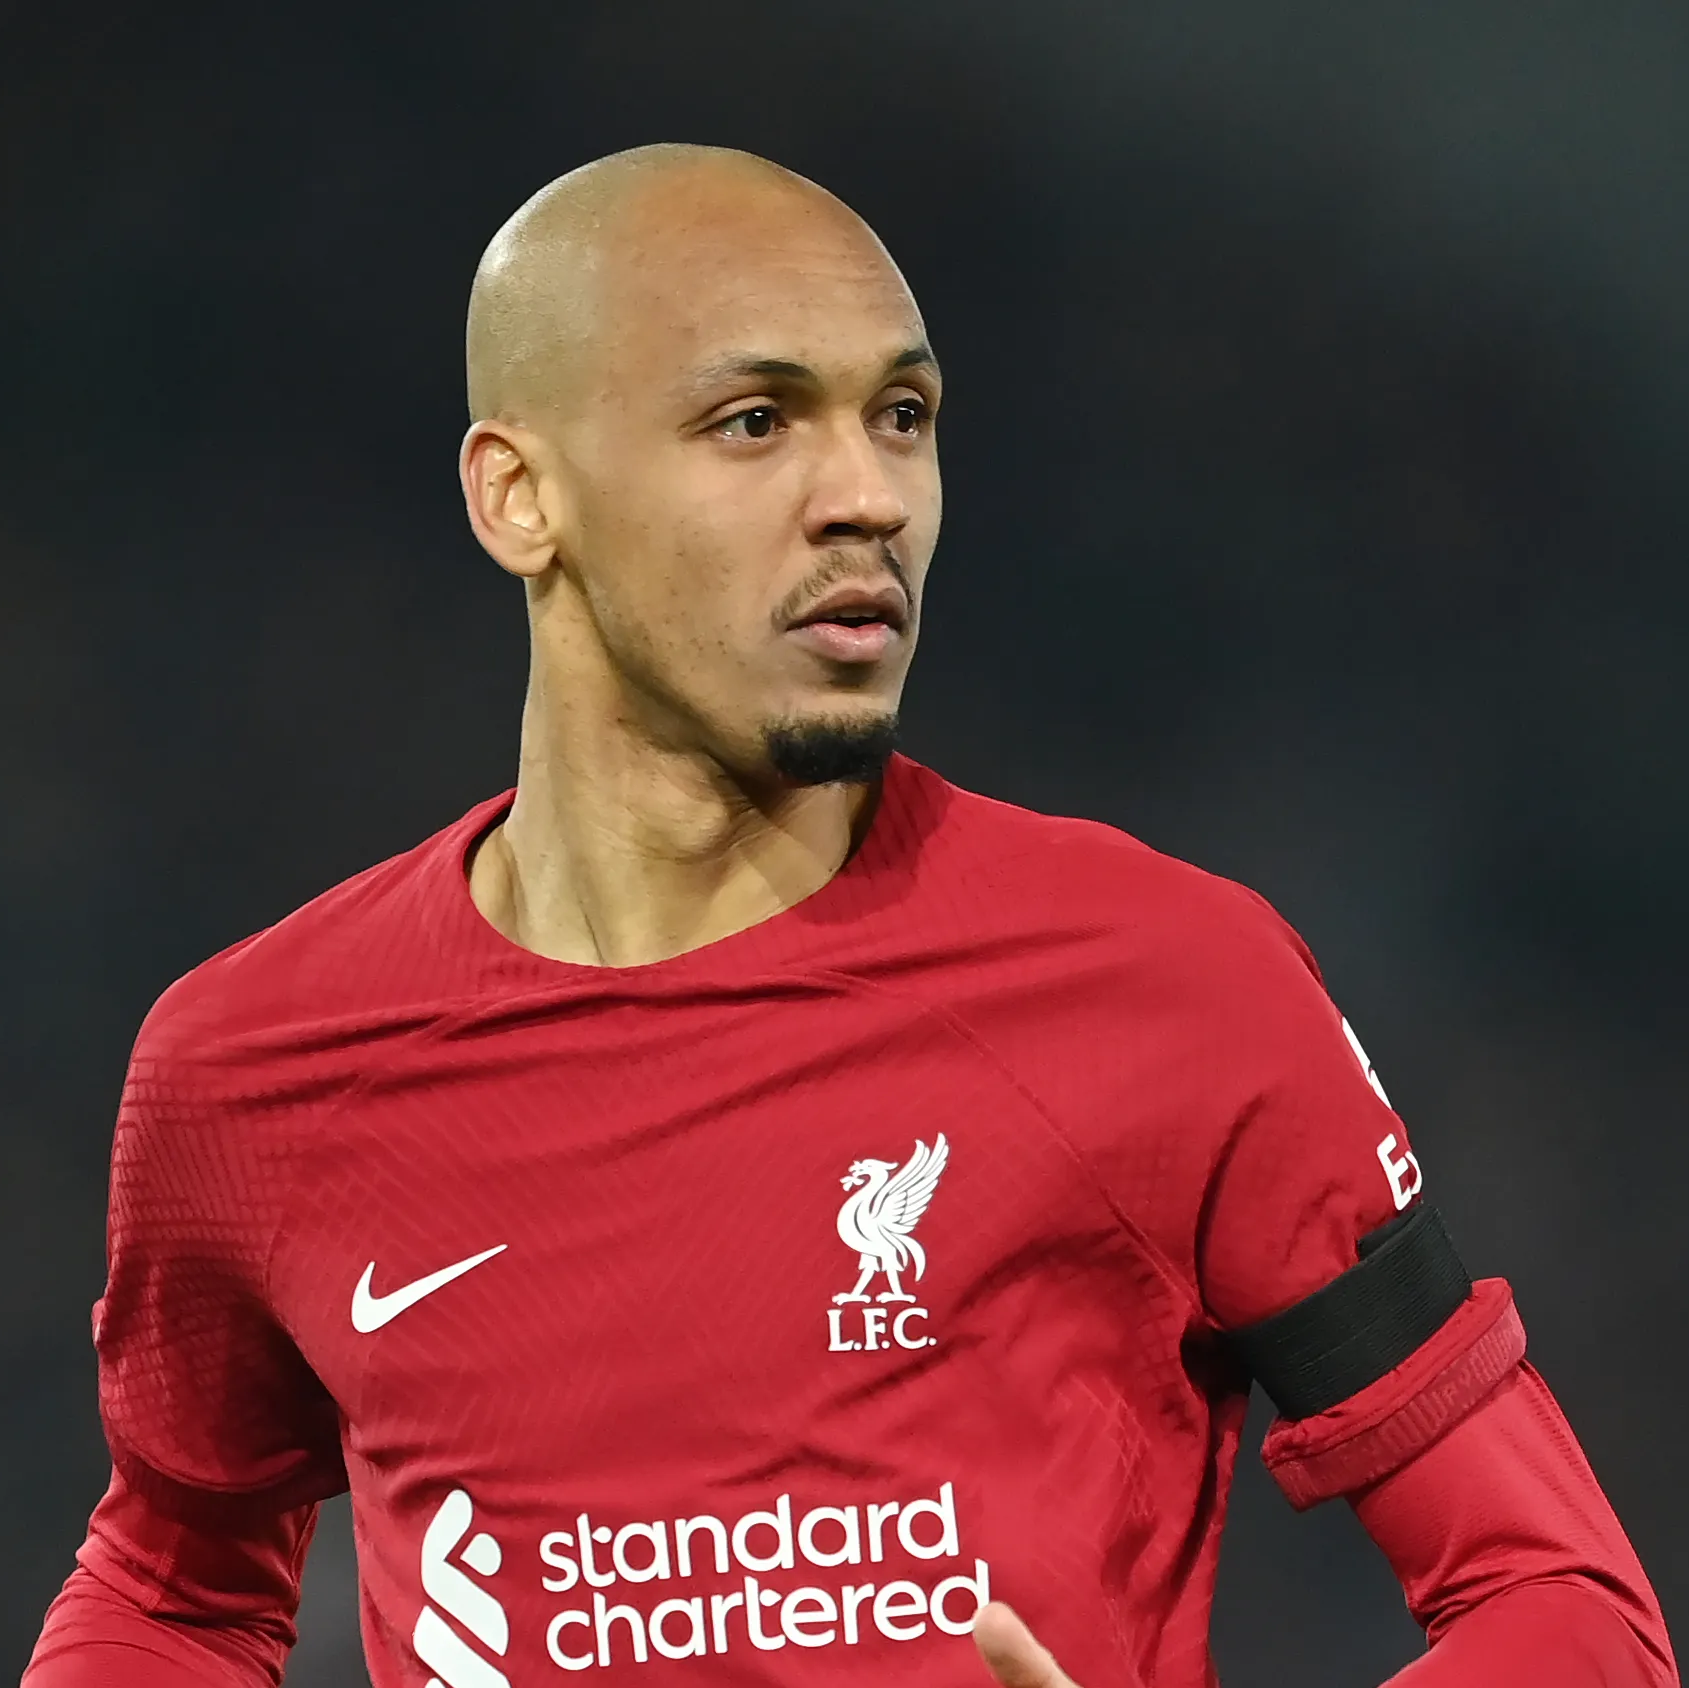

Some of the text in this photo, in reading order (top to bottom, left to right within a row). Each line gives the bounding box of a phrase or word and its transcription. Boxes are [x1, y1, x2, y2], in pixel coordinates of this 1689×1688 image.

[826, 1307, 937, 1352] L.F.C.
[539, 1481, 960, 1593] standard
[546, 1558, 990, 1671] chartered
